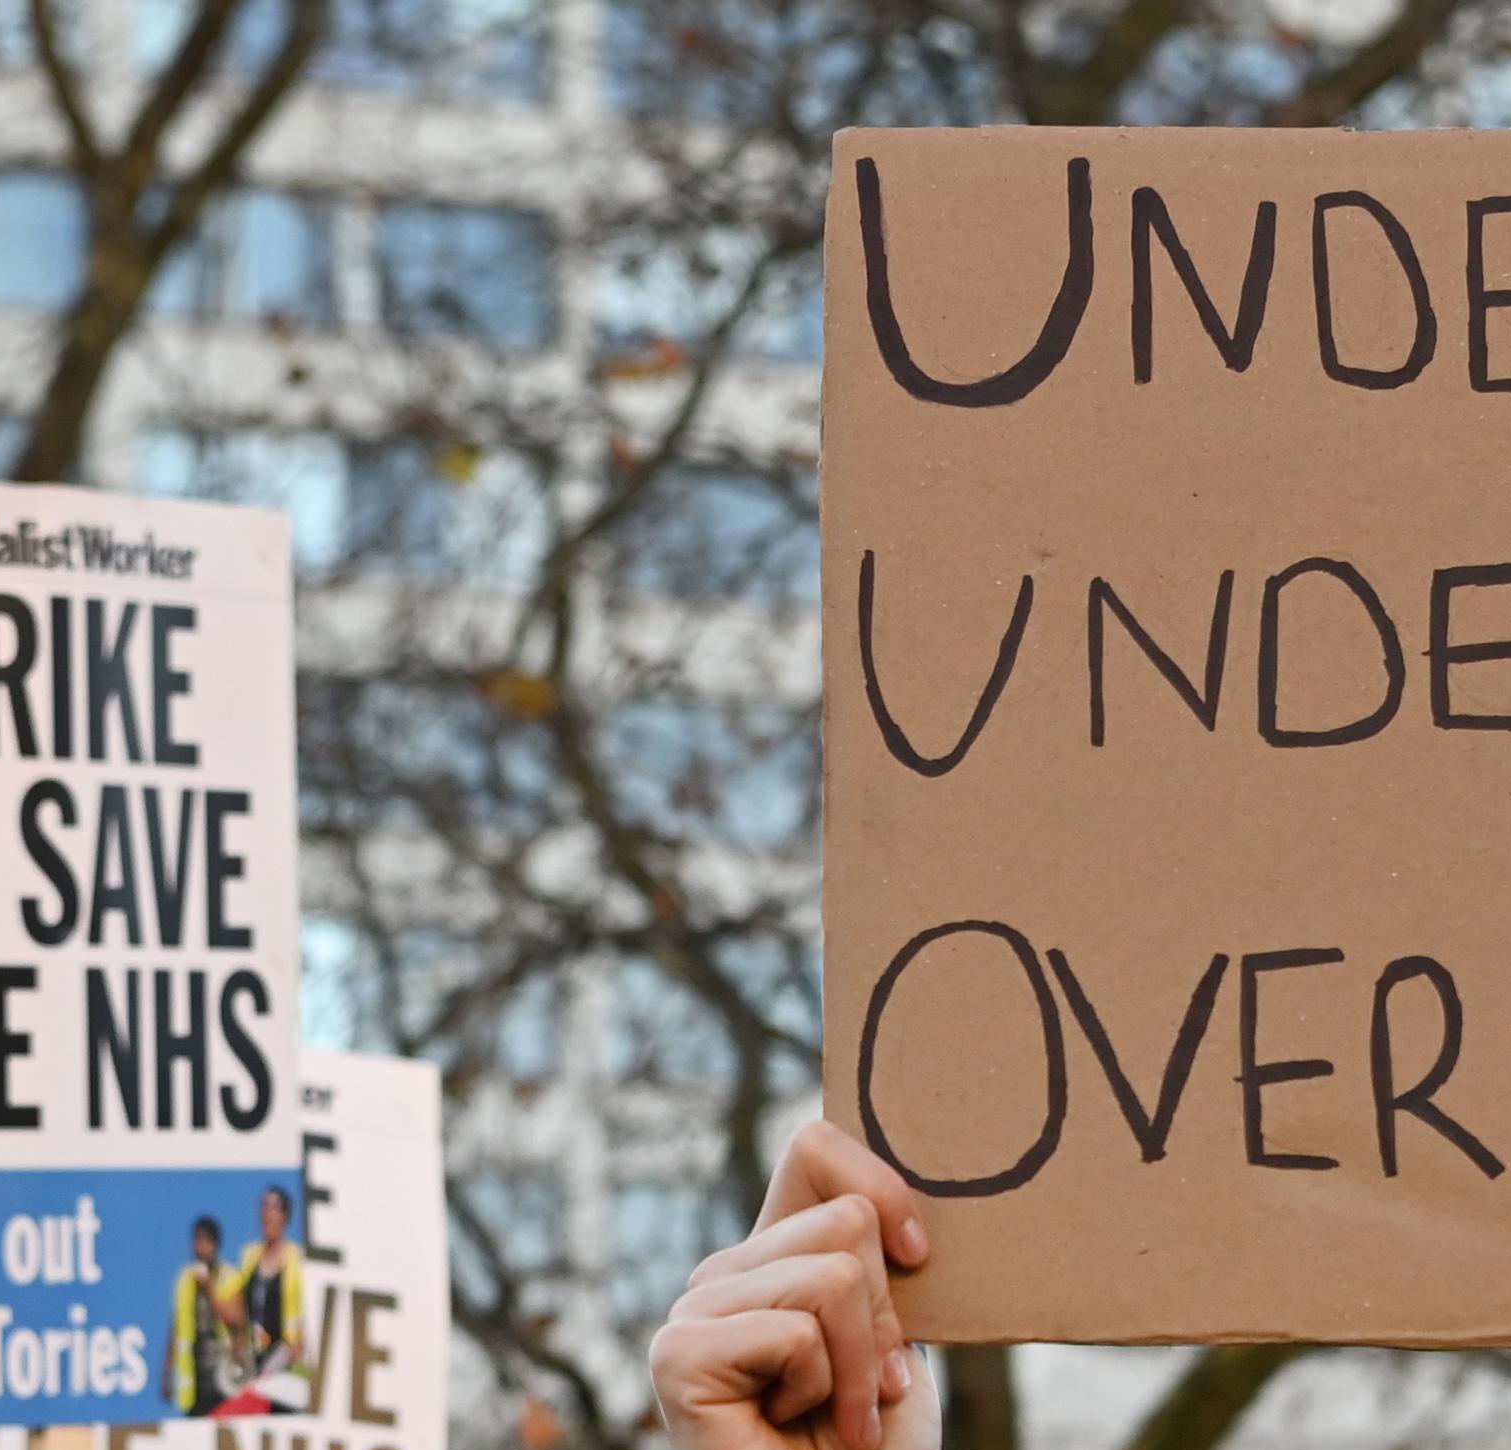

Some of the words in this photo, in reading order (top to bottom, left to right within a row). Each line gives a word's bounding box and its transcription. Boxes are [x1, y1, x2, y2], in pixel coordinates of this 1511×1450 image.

[20, 778, 255, 950] SAVE
[86, 967, 273, 1133] NHS
[857, 919, 1506, 1198] OVER
[3, 1195, 102, 1284] out
